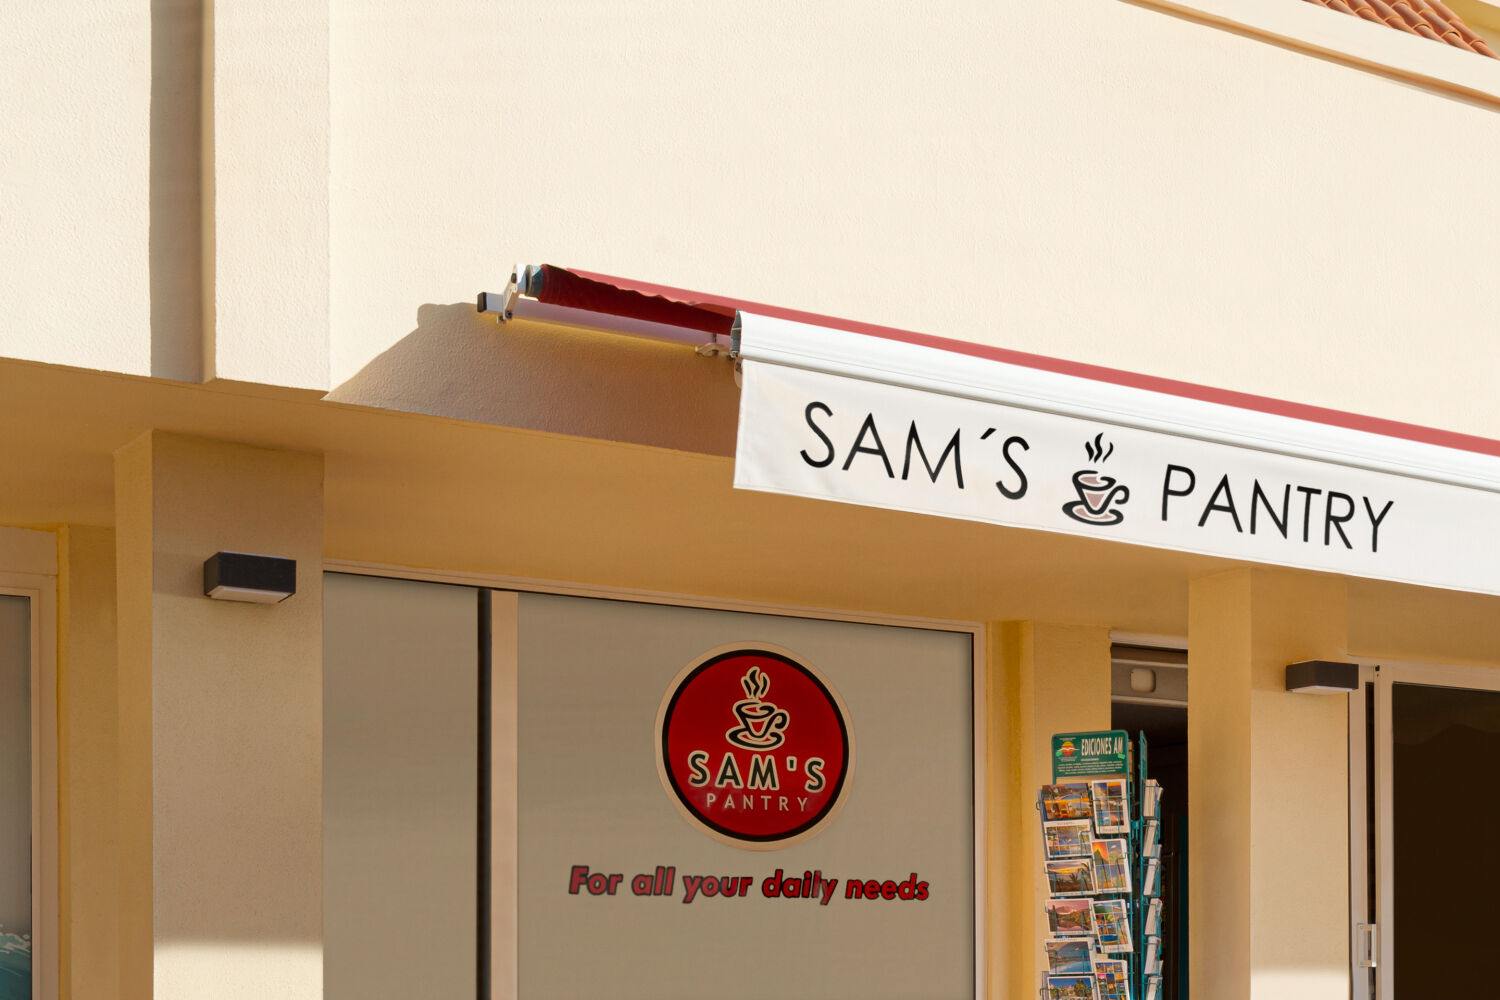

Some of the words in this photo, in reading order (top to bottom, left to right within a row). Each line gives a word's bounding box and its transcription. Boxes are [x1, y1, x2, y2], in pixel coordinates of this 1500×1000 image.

[1161, 463, 1395, 553] PANTRY
[1081, 737, 1112, 756] EDICIONES
[1113, 736, 1124, 754] AM
[688, 750, 826, 793] SAM'S
[706, 792, 808, 813] PANTRY
[568, 865, 624, 896] For
[631, 866, 676, 898] all
[682, 874, 753, 904] your
[761, 869, 838, 906] daily
[845, 872, 930, 901] needs
